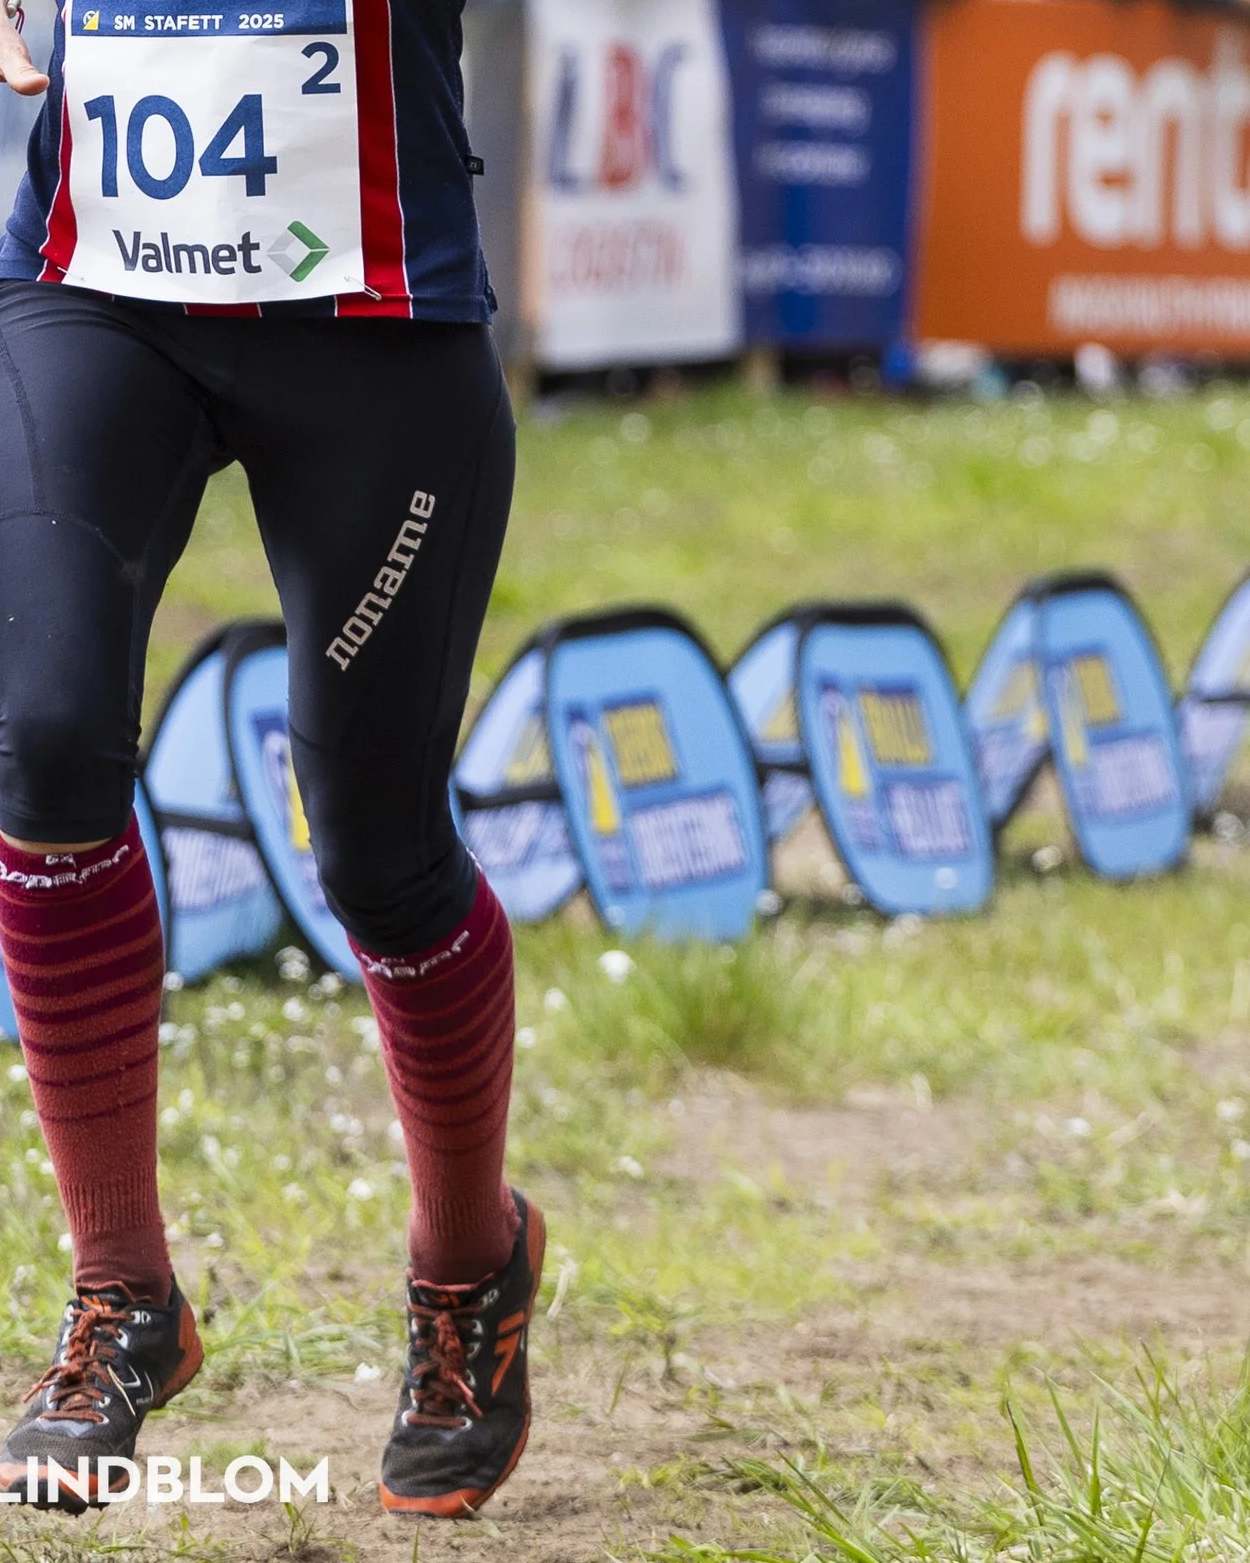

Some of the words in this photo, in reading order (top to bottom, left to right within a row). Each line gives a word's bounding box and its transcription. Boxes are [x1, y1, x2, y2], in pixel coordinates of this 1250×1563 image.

[114, 15, 135, 30] SM
[145, 14, 223, 30] STAFETT
[239, 14, 284, 30] 2025
[301, 42, 341, 94] 2
[84, 94, 278, 200] 104
[112, 229, 262, 275] Valmet
[326, 490, 436, 672] noname
